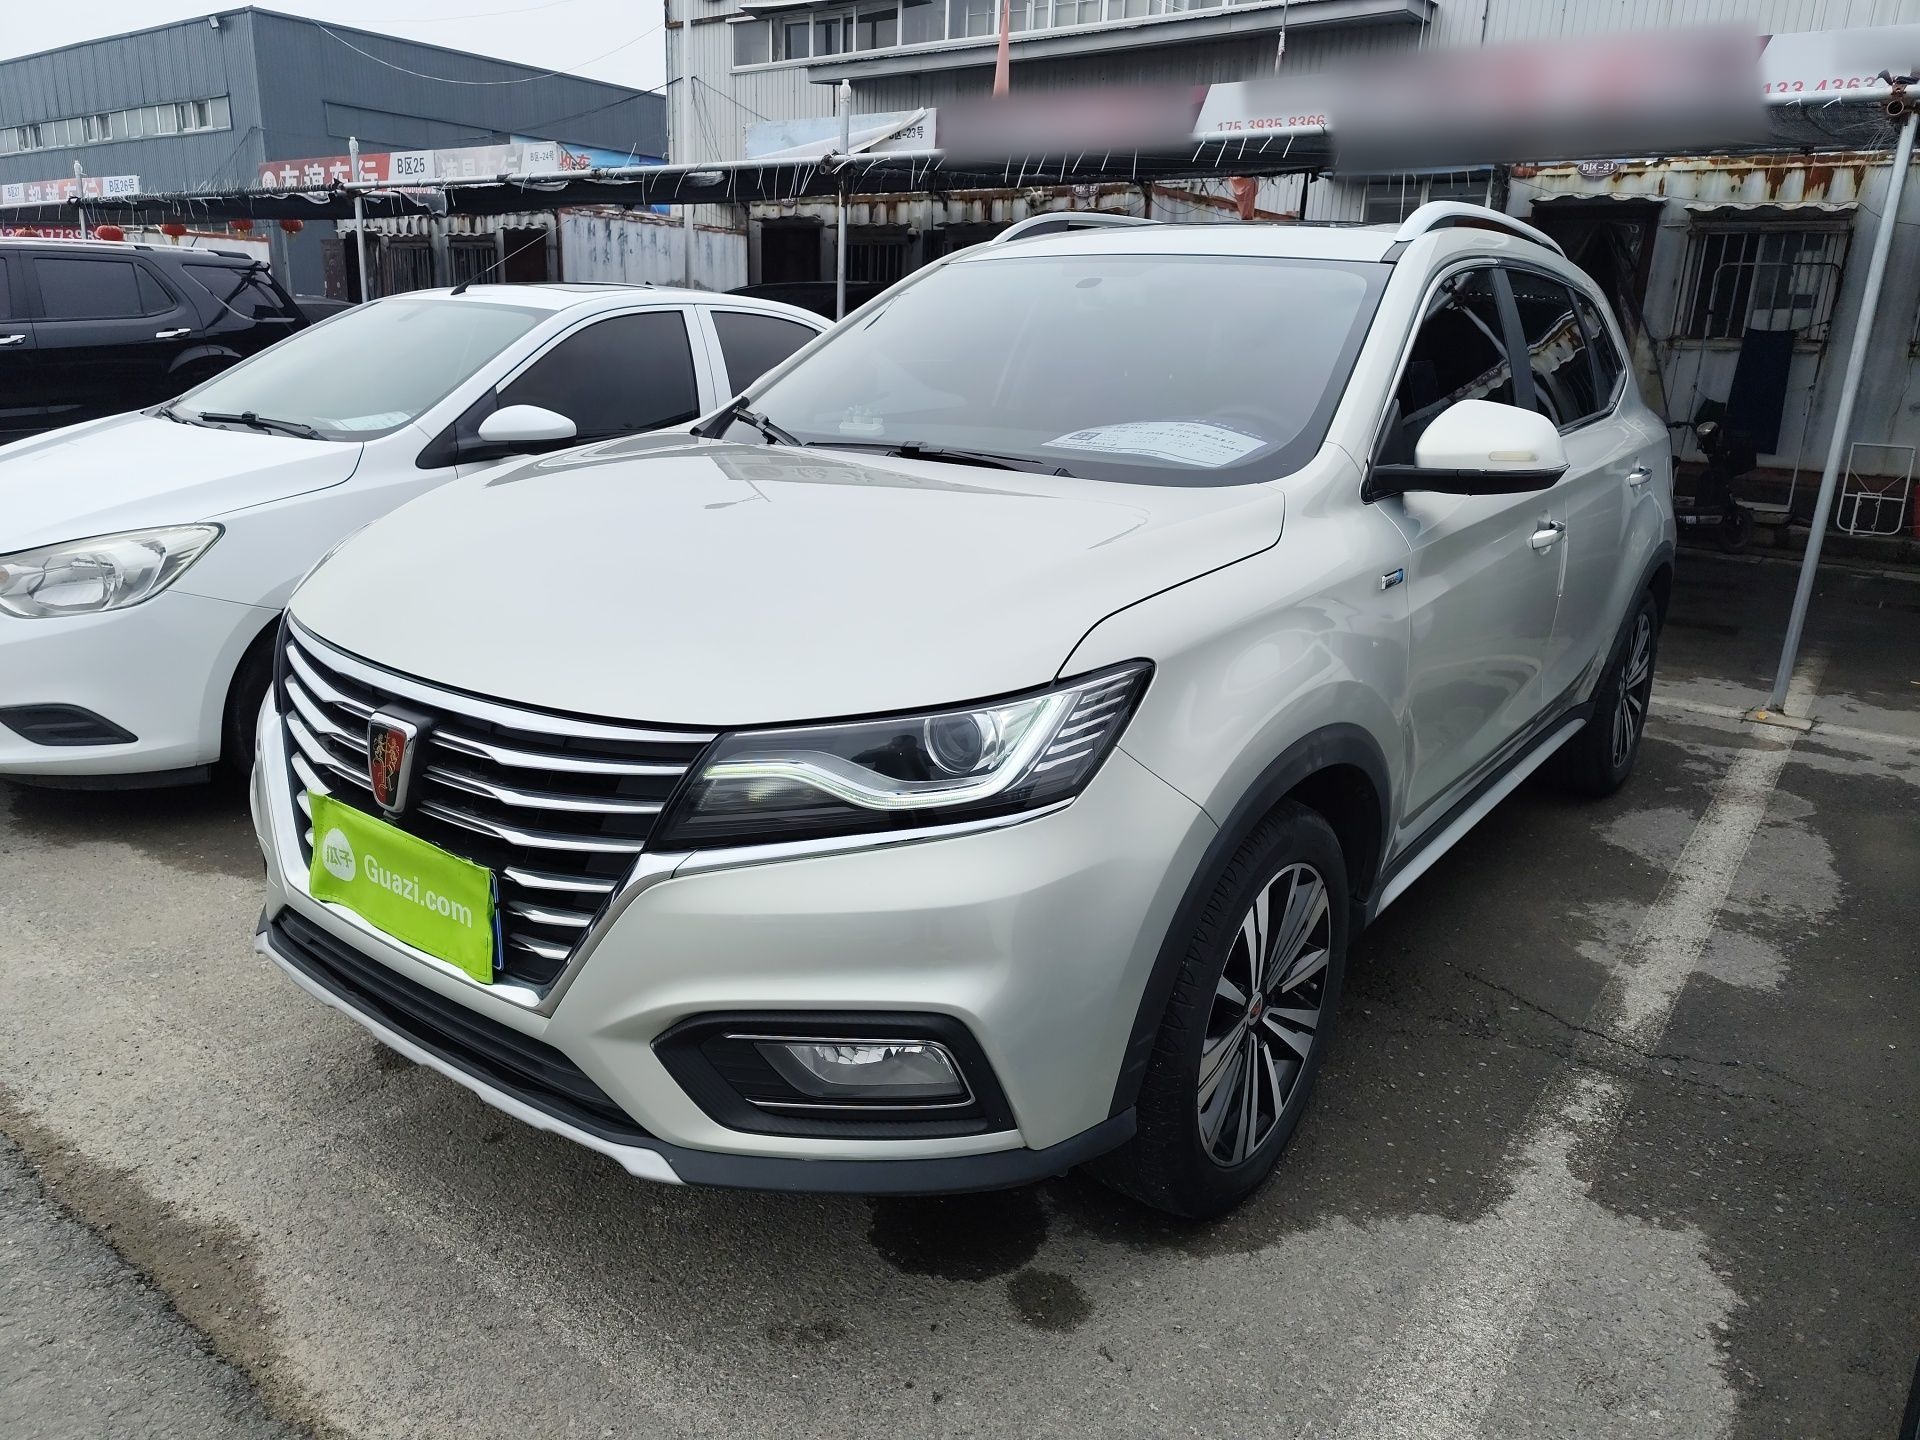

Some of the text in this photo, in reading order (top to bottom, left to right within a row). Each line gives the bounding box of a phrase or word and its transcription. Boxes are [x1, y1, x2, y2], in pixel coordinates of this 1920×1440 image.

[1289, 114, 1326, 126] 8366
[397, 157, 425, 175] B区25
[108, 178, 136, 194] B区26号
[326, 844, 353, 868] 瓜子
[364, 854, 472, 929] Guazi.com
